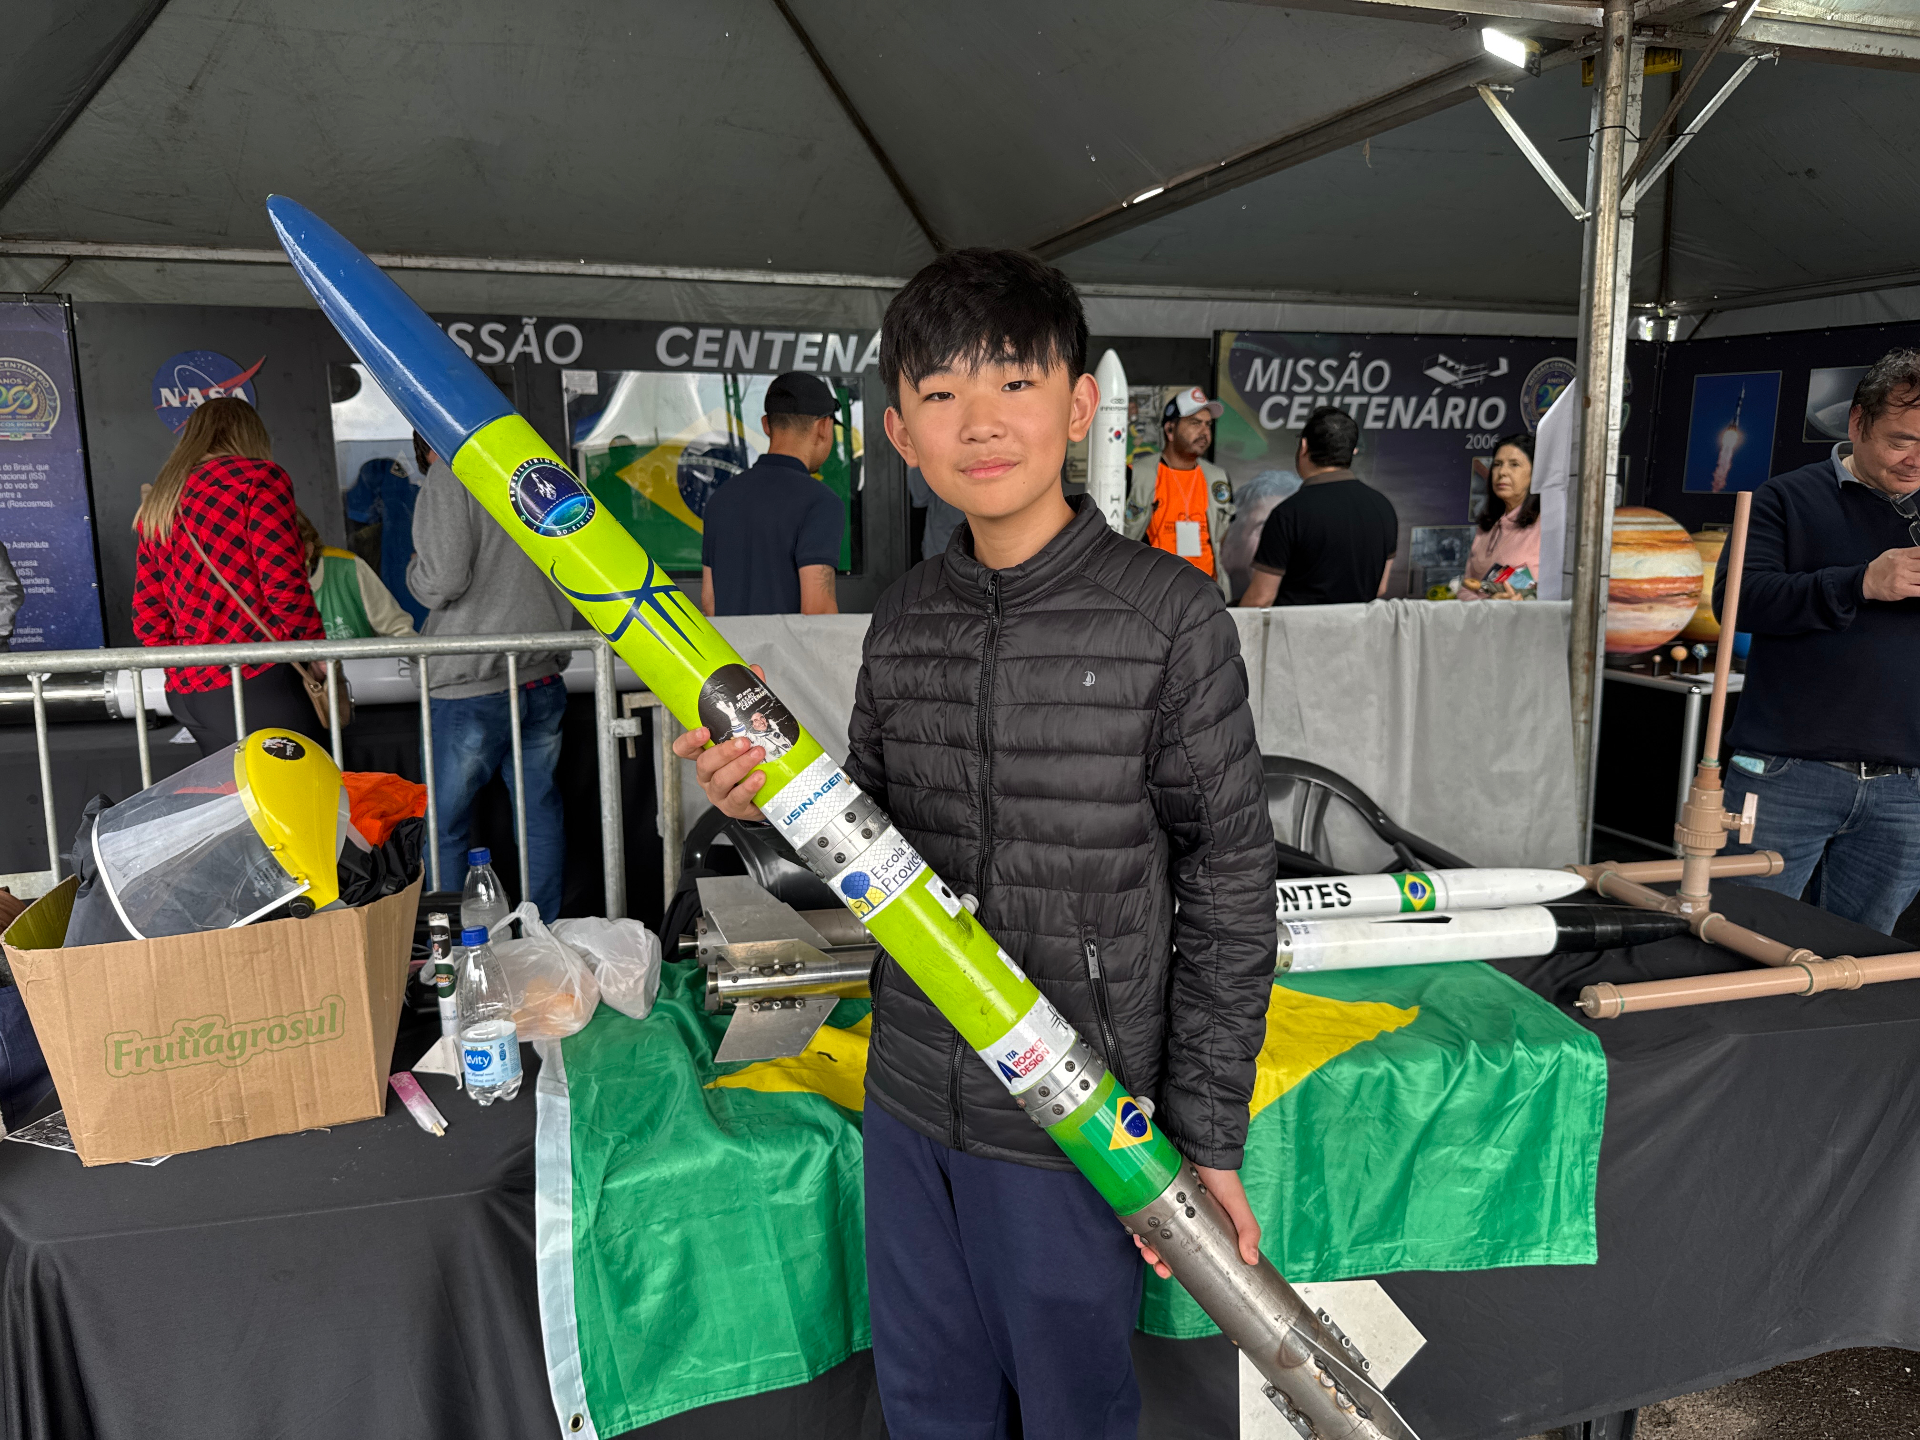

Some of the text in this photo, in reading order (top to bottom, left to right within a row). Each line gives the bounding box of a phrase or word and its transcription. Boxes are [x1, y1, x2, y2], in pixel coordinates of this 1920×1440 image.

[437, 317, 583, 365] SSÃO
[1244, 351, 1391, 393] MISSÃO
[13, 463, 35, 472] Brasil,
[28, 472, 46, 481] (ISS)
[782, 772, 845, 826] USINAGEM
[870, 847, 906, 880] Escola
[1276, 882, 1352, 912] NTES
[114, 1002, 338, 1070] Frutiagrosul
[1005, 1050, 1019, 1062] ITA
[1012, 1037, 1046, 1069] ROCKET
[1018, 1047, 1050, 1078] DESIGN
